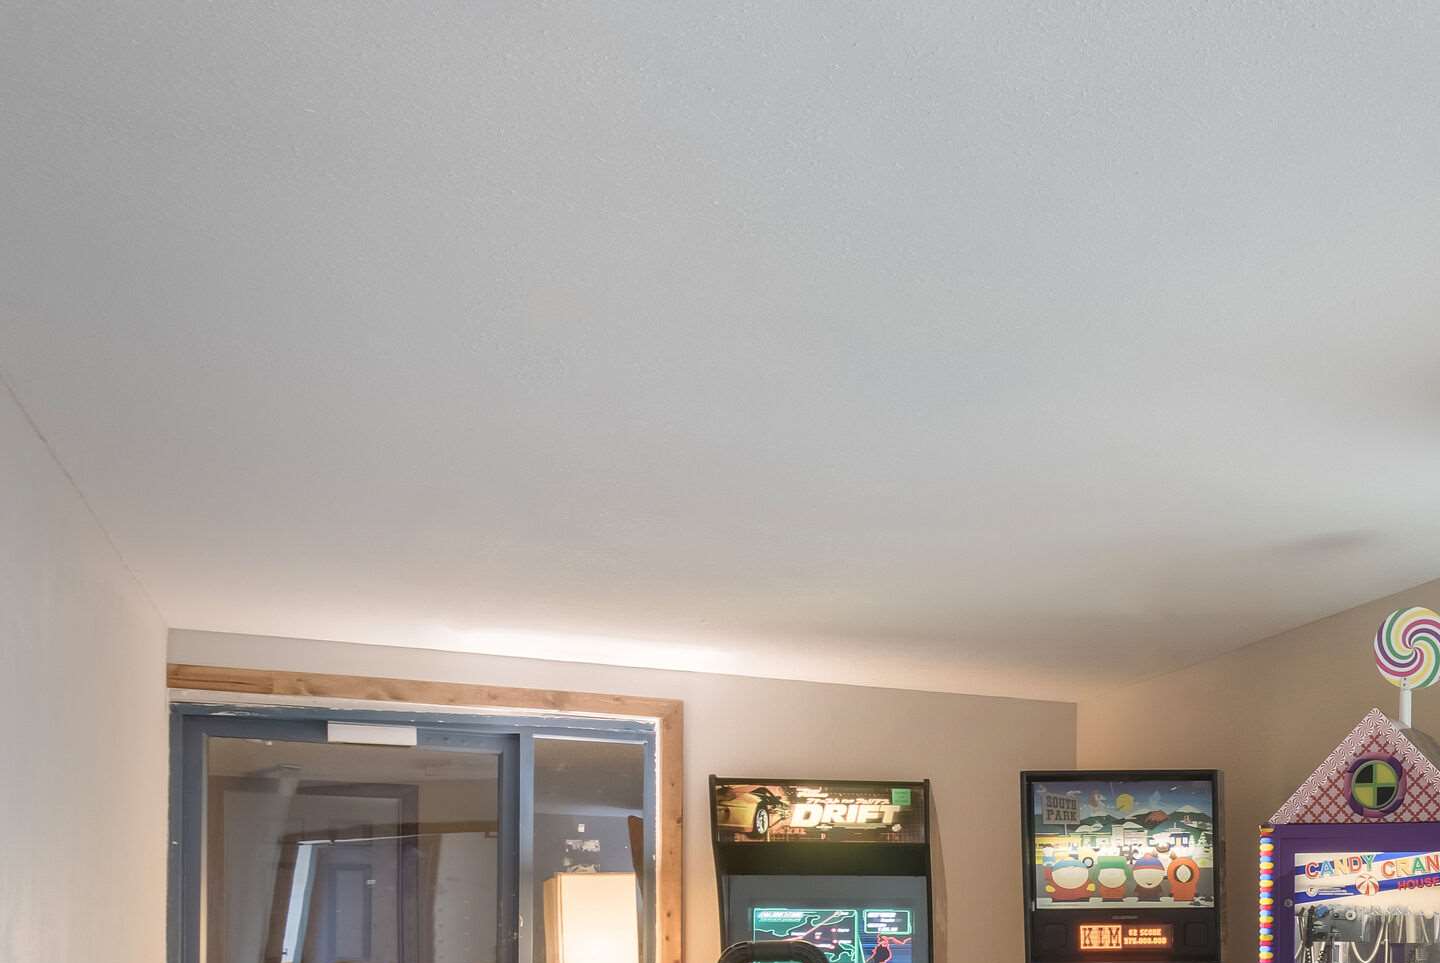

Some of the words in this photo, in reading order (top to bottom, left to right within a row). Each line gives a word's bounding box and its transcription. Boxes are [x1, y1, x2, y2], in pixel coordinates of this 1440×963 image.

[790, 803, 901, 828] DRIFT
[1047, 809, 1077, 821] PARK
[1305, 854, 1376, 879] CANDY
[1397, 876, 1440, 891] HOUSE
[1081, 926, 1121, 947] KIM
